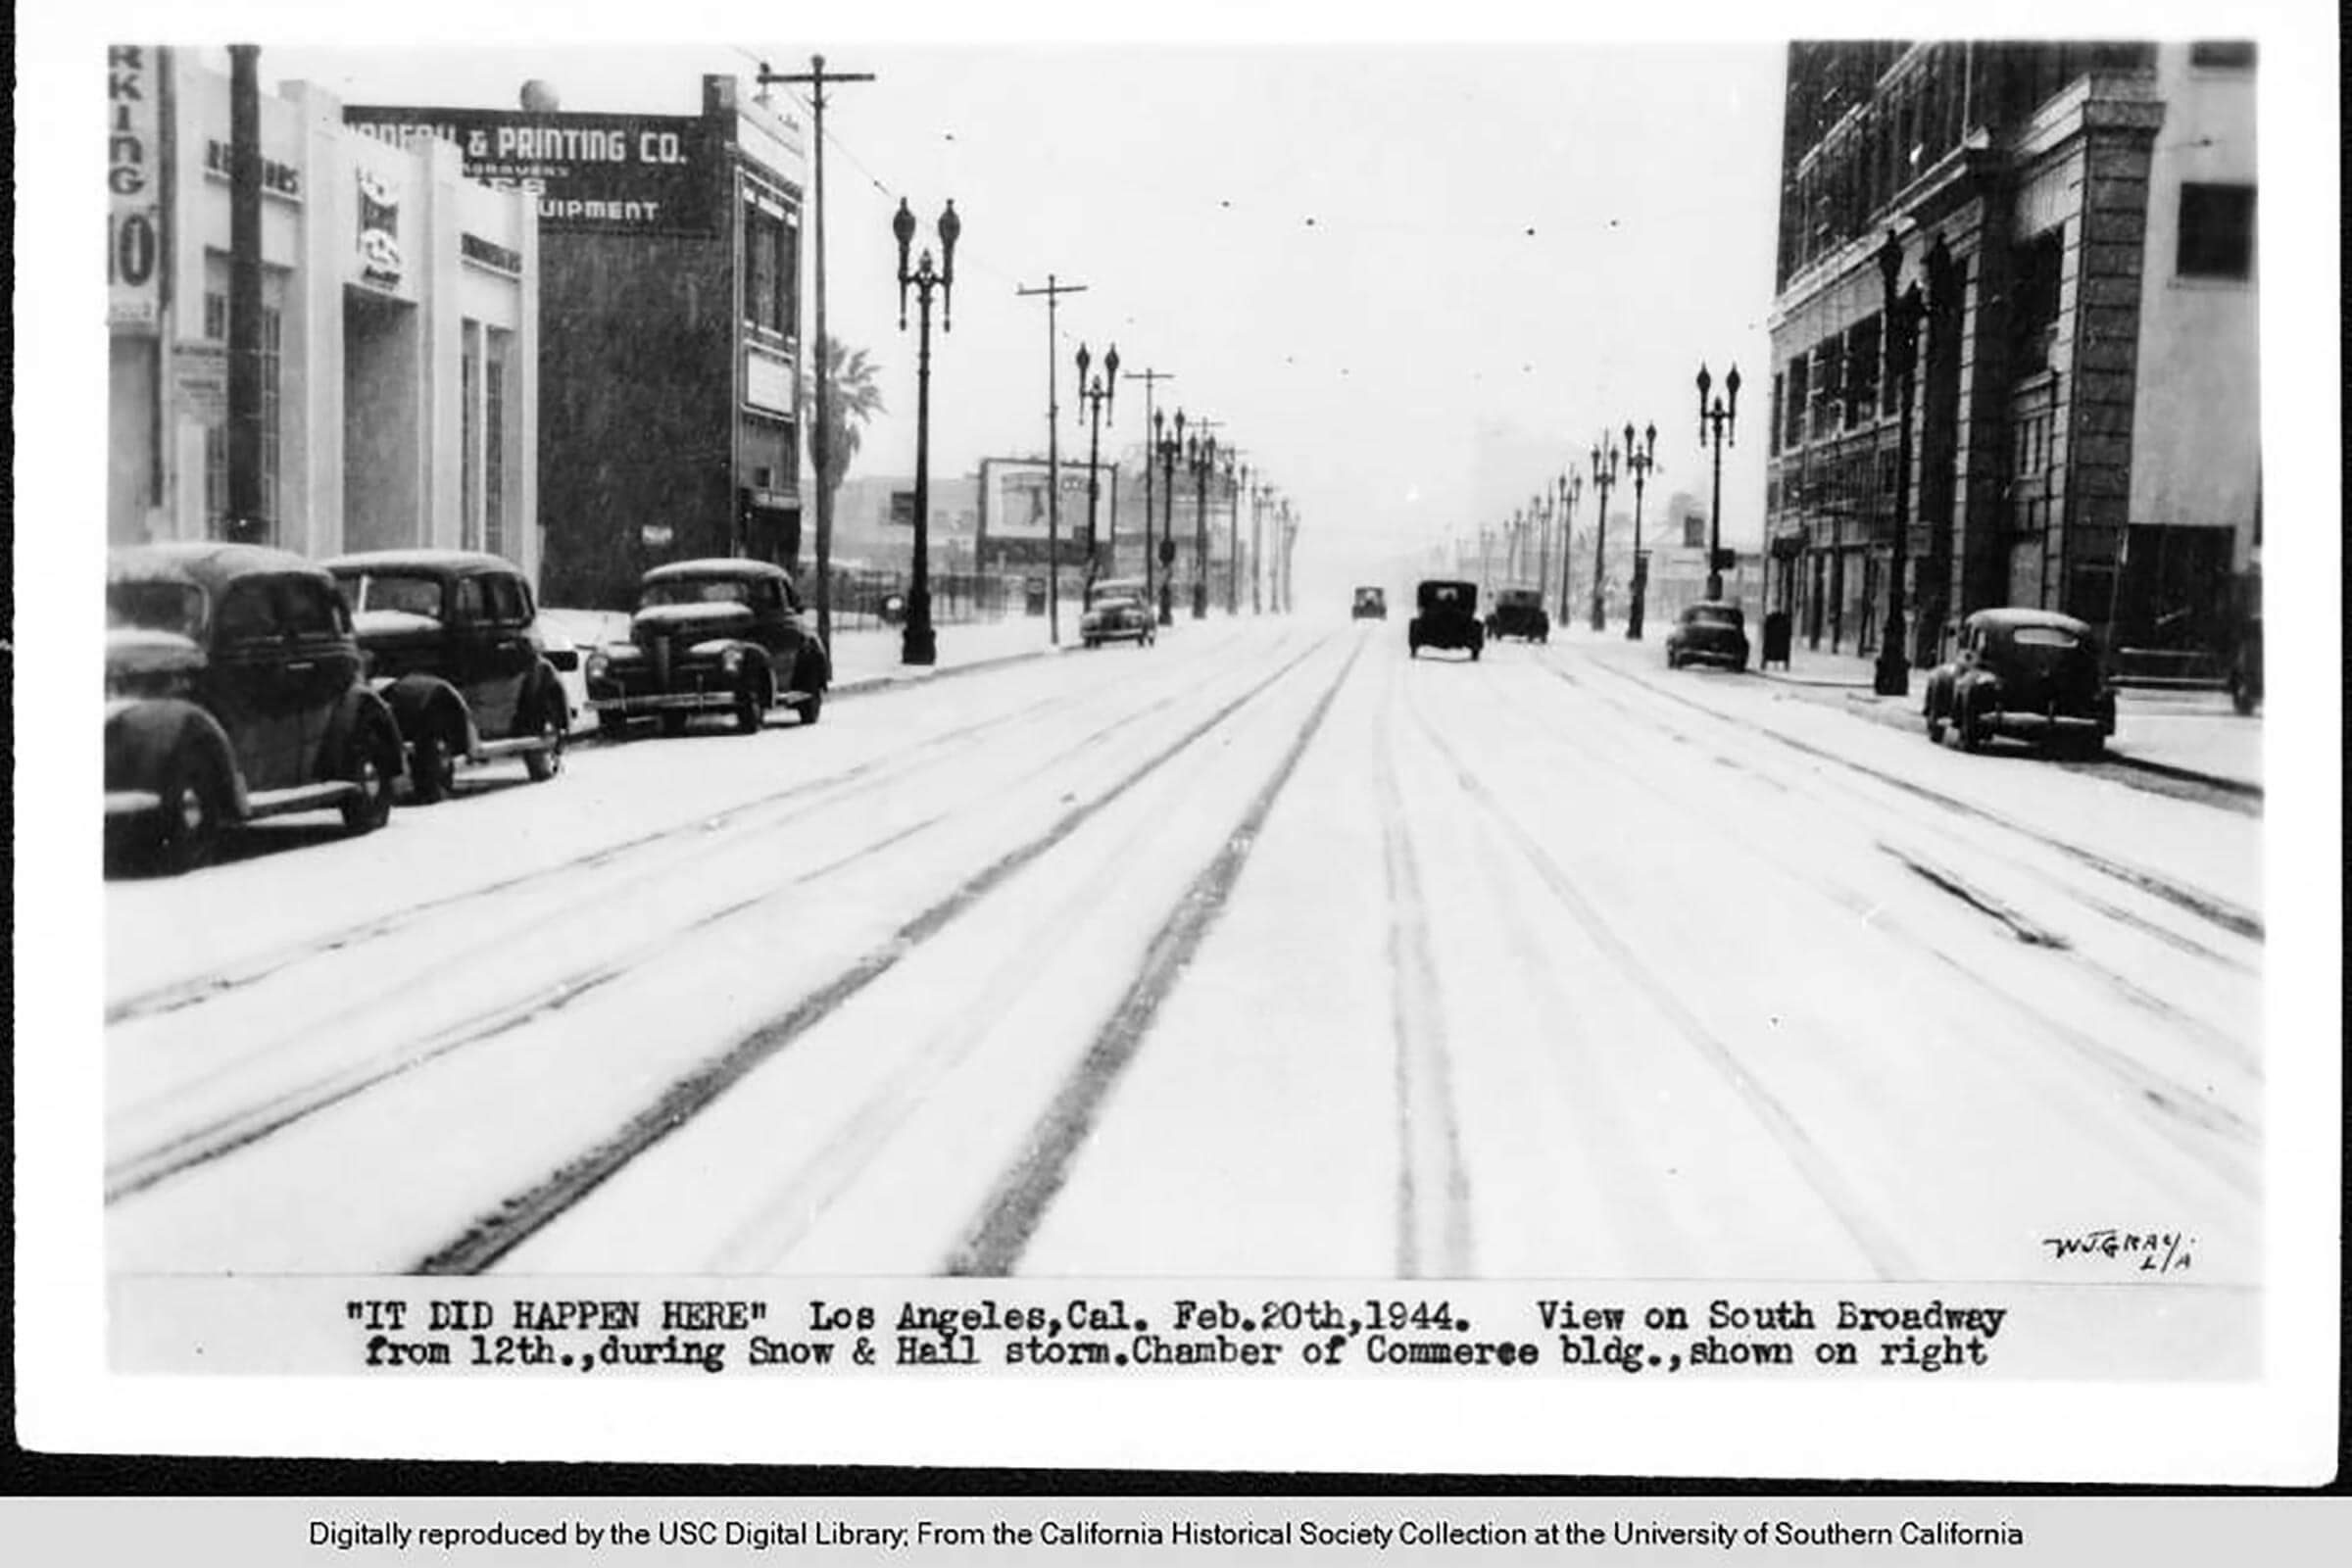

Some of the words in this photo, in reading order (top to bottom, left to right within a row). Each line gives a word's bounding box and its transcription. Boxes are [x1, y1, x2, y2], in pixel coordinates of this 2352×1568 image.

[469, 130, 488, 157] &
[498, 127, 626, 162] PRINTING
[640, 132, 687, 164] CO.
